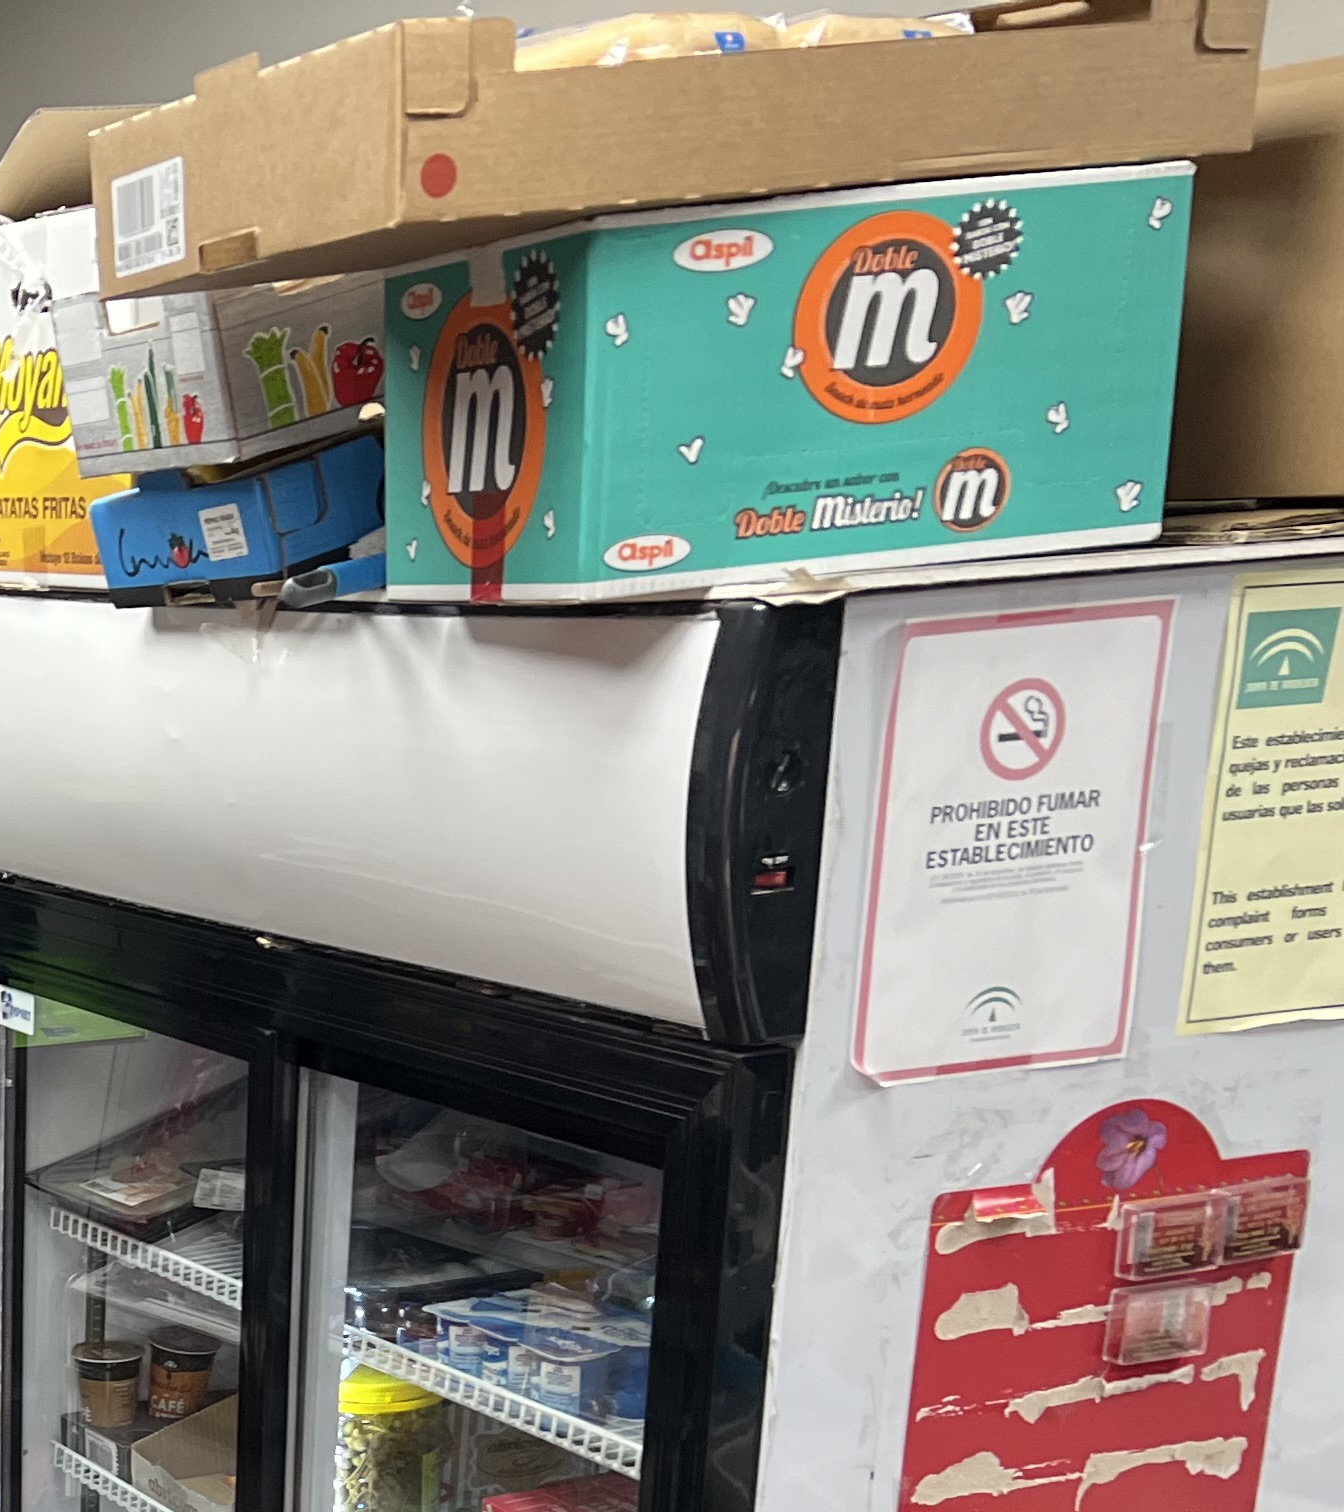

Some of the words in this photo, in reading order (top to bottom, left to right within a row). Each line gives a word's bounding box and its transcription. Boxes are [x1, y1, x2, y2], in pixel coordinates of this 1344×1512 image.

[851, 245, 919, 274] Doble
[42, 496, 87, 520] FRITAS
[735, 506, 806, 540] Doble
[1232, 735, 1259, 749] Este
[1229, 757, 1269, 776] quejas
[1272, 758, 1282, 775] y
[1226, 783, 1242, 798] de
[1252, 779, 1270, 796] las
[1281, 775, 1339, 795] personas
[930, 796, 1032, 824] PROHIBIDO
[1036, 789, 1102, 813] FUMAR
[1222, 803, 1275, 821] usuarias
[1279, 801, 1303, 818] que
[1306, 798, 1324, 814] las
[974, 822, 1001, 842] EN
[1007, 816, 1052, 839] ESTE
[926, 834, 1095, 869] ESTABLECIMIENTO
[1212, 889, 1238, 905] This
[1246, 881, 1334, 902] establishment
[1208, 910, 1271, 929] complaint
[1291, 905, 1328, 920] forms
[1205, 934, 1274, 952] consumers
[1283, 932, 1299, 943] or
[1306, 927, 1343, 941] users
[1202, 960, 1237, 975] them.
[150, 1395, 186, 1414] CAFÉ
